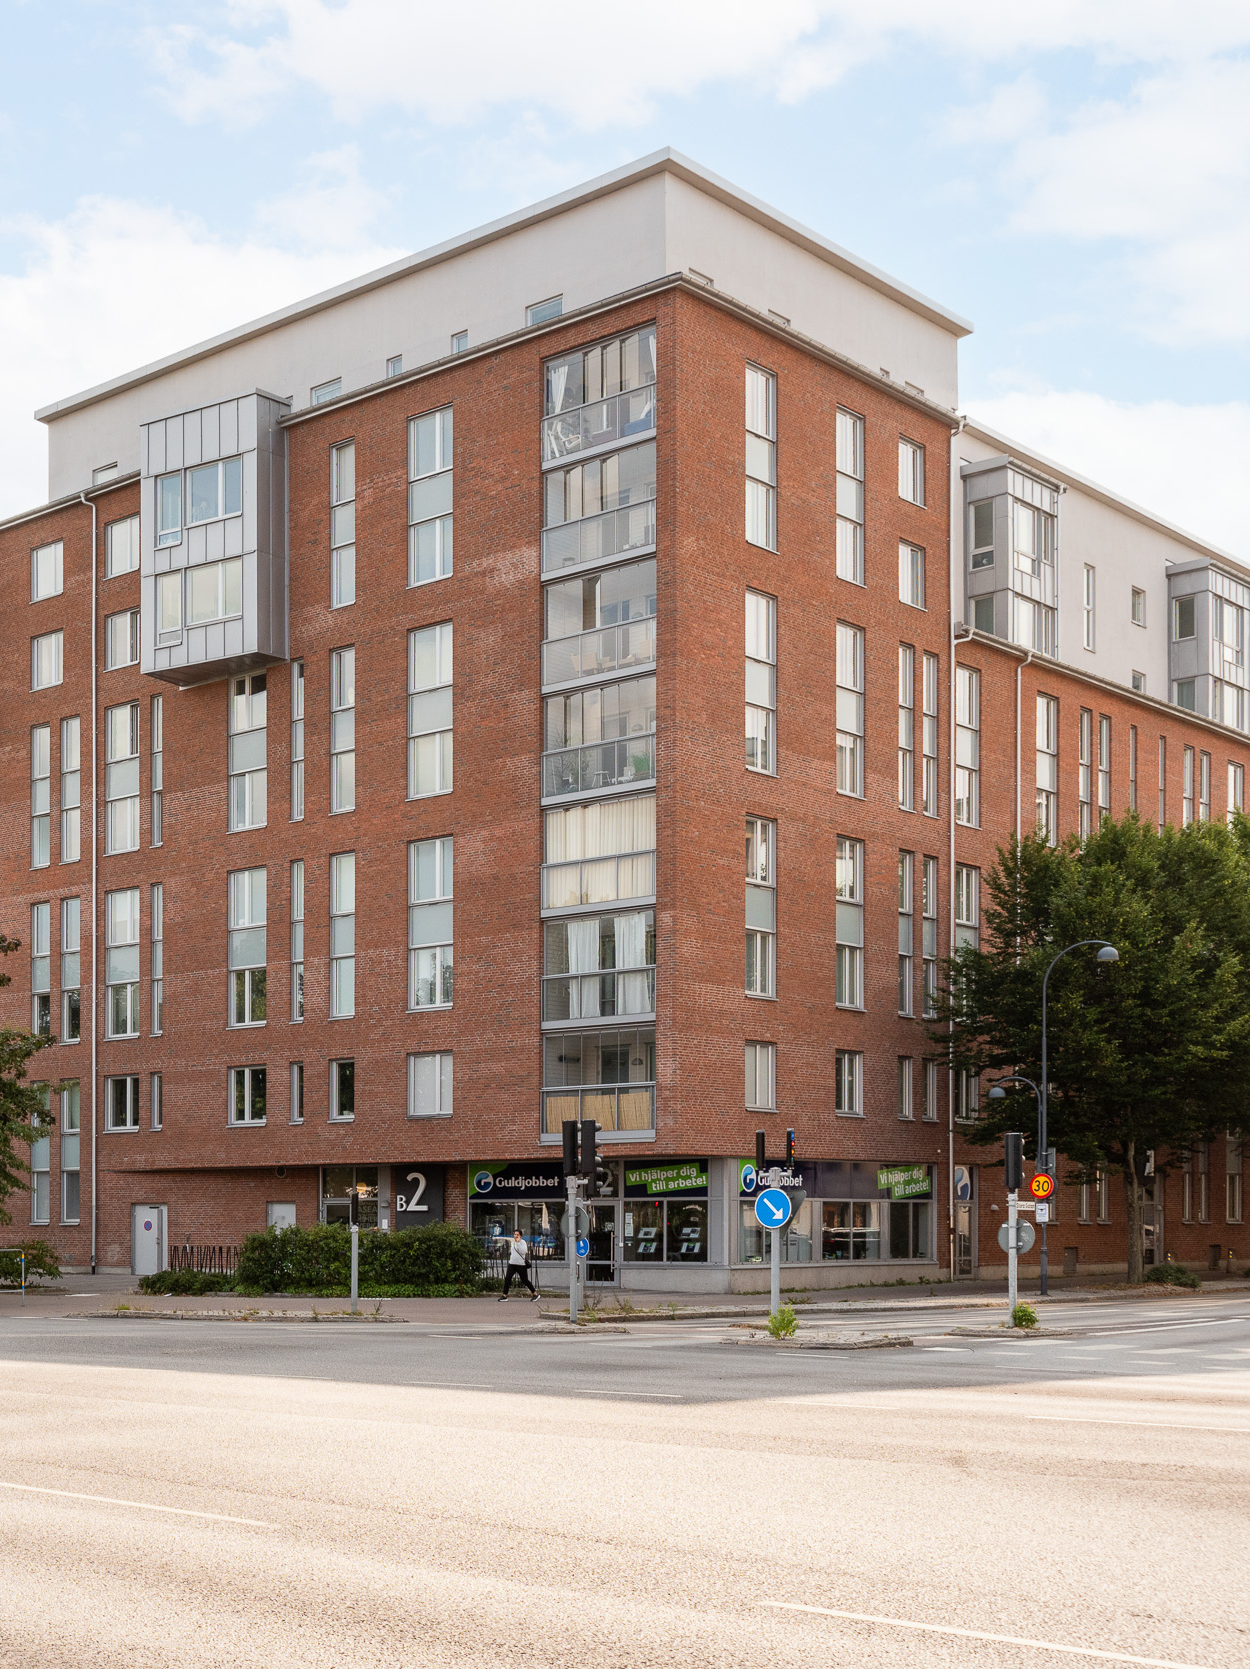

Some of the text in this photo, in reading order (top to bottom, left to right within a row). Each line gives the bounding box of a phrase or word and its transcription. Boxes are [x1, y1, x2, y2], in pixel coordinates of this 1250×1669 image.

[629, 1166, 697, 1182] Vi hjälper dig
[758, 1174, 803, 1187] Guobbet
[880, 1167, 923, 1185] Vi hjälper dig
[495, 1175, 560, 1191] Guldjobbet
[652, 1175, 707, 1191] till arbete!
[894, 1179, 929, 1196] till arbete!
[1033, 1179, 1050, 1193] 30
